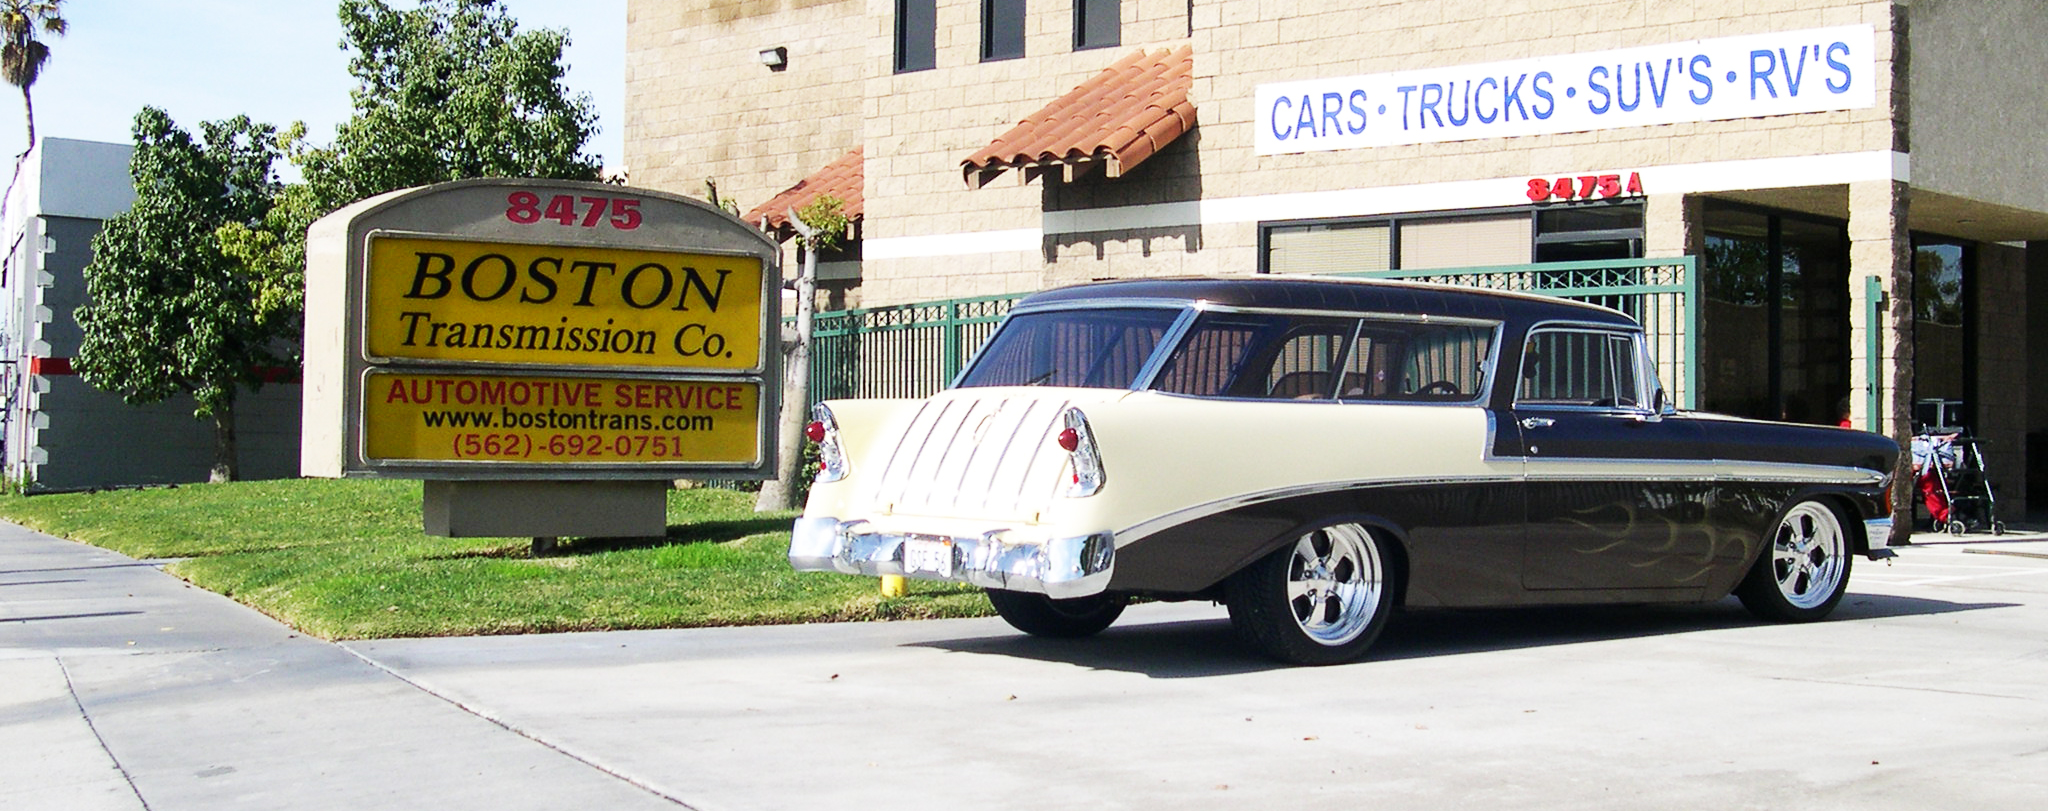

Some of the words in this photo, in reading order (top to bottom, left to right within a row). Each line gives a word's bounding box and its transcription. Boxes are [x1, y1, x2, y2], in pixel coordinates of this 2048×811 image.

[1270, 87, 1368, 141] CARS
[1396, 70, 1555, 131] TRUCKS
[1587, 54, 1713, 115] SUV'S
[1749, 40, 1853, 100] RV'S
[1526, 174, 1622, 202] 8475
[1626, 171, 1643, 194] A
[505, 191, 642, 231] 8475
[403, 251, 733, 314] BOSTON
[399, 310, 656, 355] Transmission
[674, 323, 733, 359] Co.
[386, 379, 602, 408] AUTOMOTIVE
[615, 385, 743, 411] SERVICE
[422, 406, 715, 432] www.bostontrans.com
[453, 433, 682, 459] (562)-692-0751
